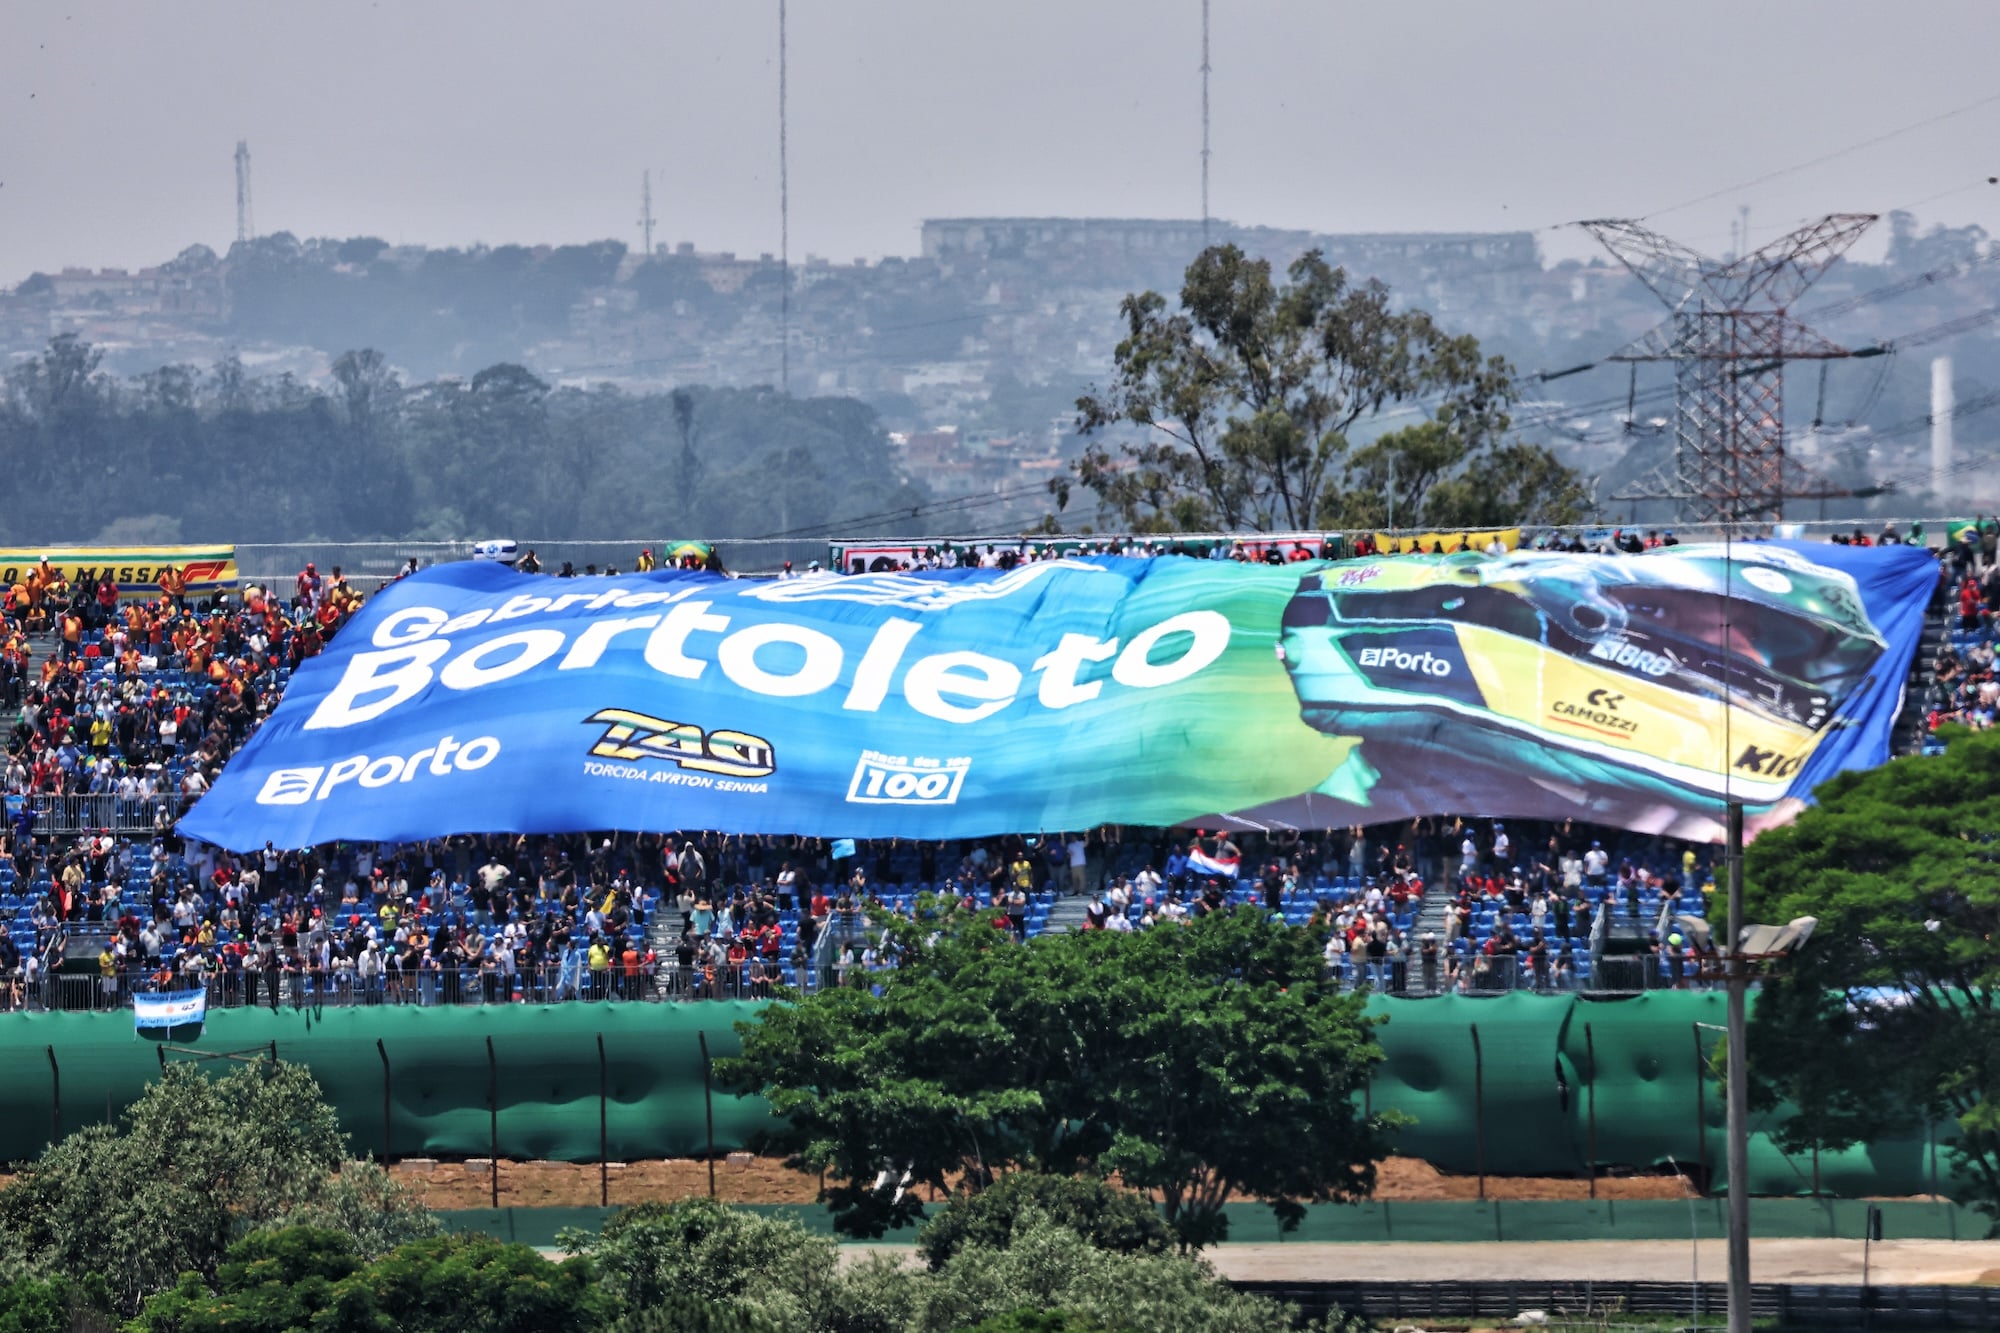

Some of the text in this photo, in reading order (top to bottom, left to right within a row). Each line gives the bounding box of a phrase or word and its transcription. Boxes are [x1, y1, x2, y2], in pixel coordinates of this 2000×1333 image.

[372, 586, 707, 648] Gabriel
[303, 600, 1231, 730] Bortoleto
[1380, 647, 1451, 677] Porto
[1552, 701, 1638, 732] CAMOZZI
[316, 736, 501, 800] Porto
[583, 762, 769, 794] TORCIDA AYRTON SENNA
[866, 768, 949, 799] 100
